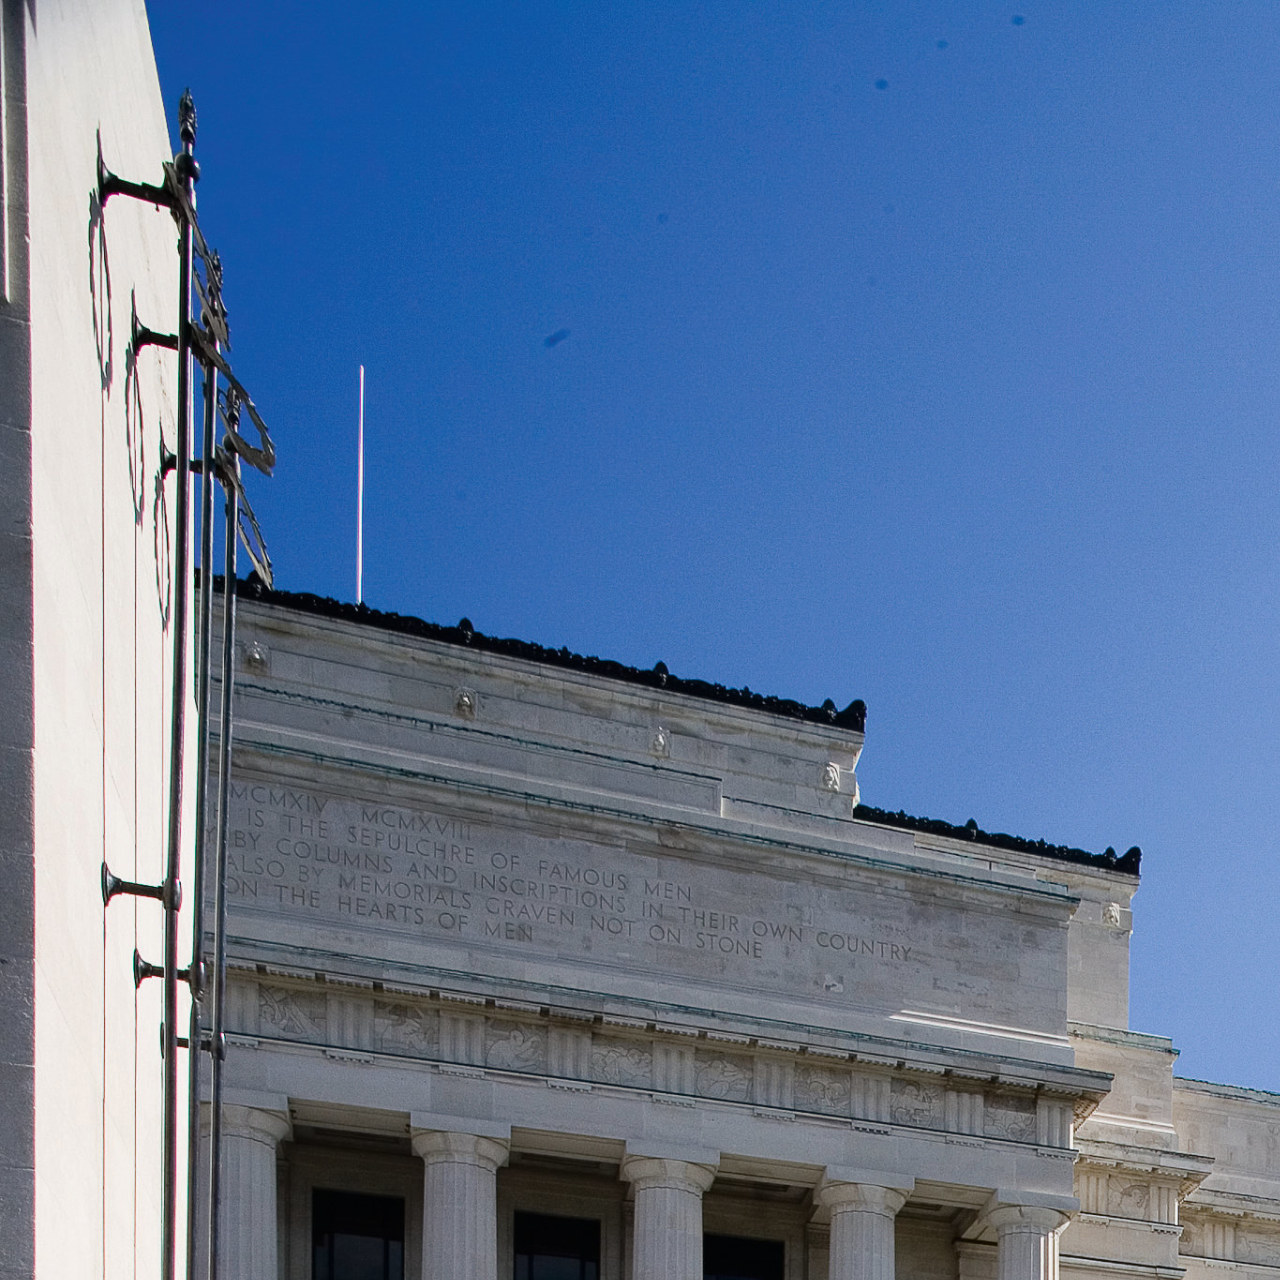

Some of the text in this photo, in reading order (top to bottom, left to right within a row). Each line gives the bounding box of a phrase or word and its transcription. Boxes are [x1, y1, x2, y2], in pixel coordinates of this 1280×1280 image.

[229, 783, 329, 814] MCMXIV
[362, 807, 471, 841] MCMXVIII
[248, 808, 691, 901] IS THE SEPULCHRE OF FAMOUS MEN
[234, 830, 261, 850] BY
[276, 838, 393, 874] COLUMNS
[407, 862, 457, 884] AND
[474, 872, 626, 914] INSCRIPTIONS
[642, 900, 663, 918] IN
[678, 906, 739, 933] THEIR
[752, 920, 803, 943] OWN
[816, 931, 912, 962] COUNTRY
[274, 884, 320, 909] THE
[338, 896, 424, 925] HEARTS
[438, 912, 468, 932] OF
[485, 921, 533, 942] MEN
[299, 864, 325, 885] BY
[339, 873, 471, 911] MEMORIALS
[486, 897, 575, 927] GRAVEN
[591, 915, 636, 937] NOT
[650, 924, 682, 945] ON
[696, 932, 763, 959] STONE
